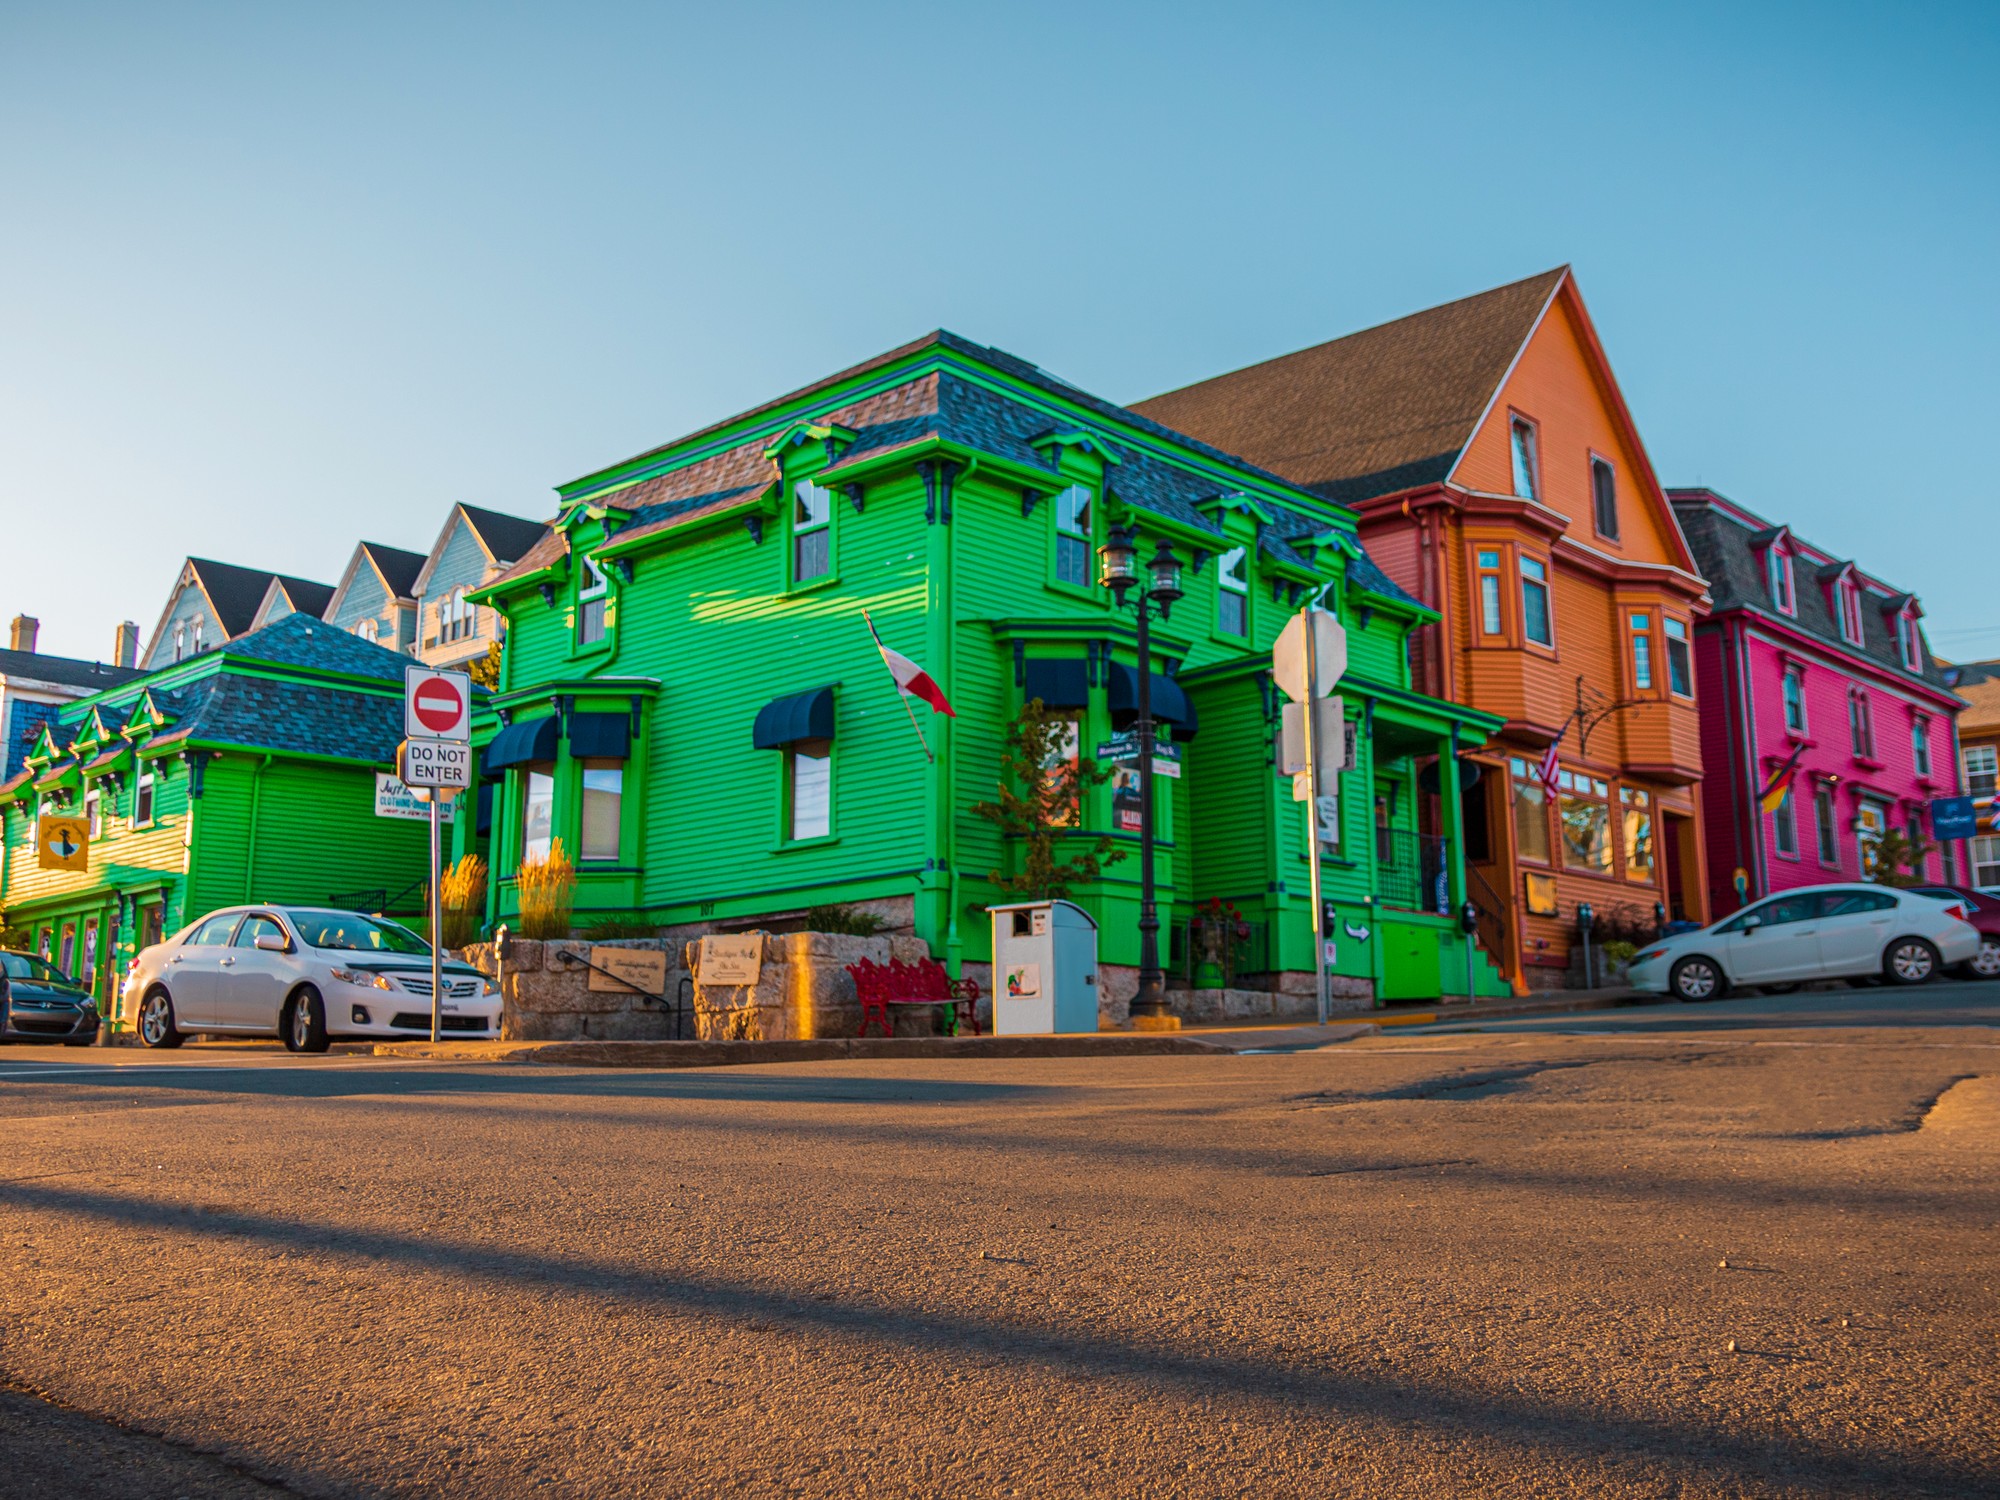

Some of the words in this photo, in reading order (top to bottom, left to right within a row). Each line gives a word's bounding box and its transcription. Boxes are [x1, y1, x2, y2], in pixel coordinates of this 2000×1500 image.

[412, 746, 433, 760] DO
[437, 749, 466, 763] NOT
[415, 764, 462, 780] ENTER
[701, 903, 714, 917] 107
